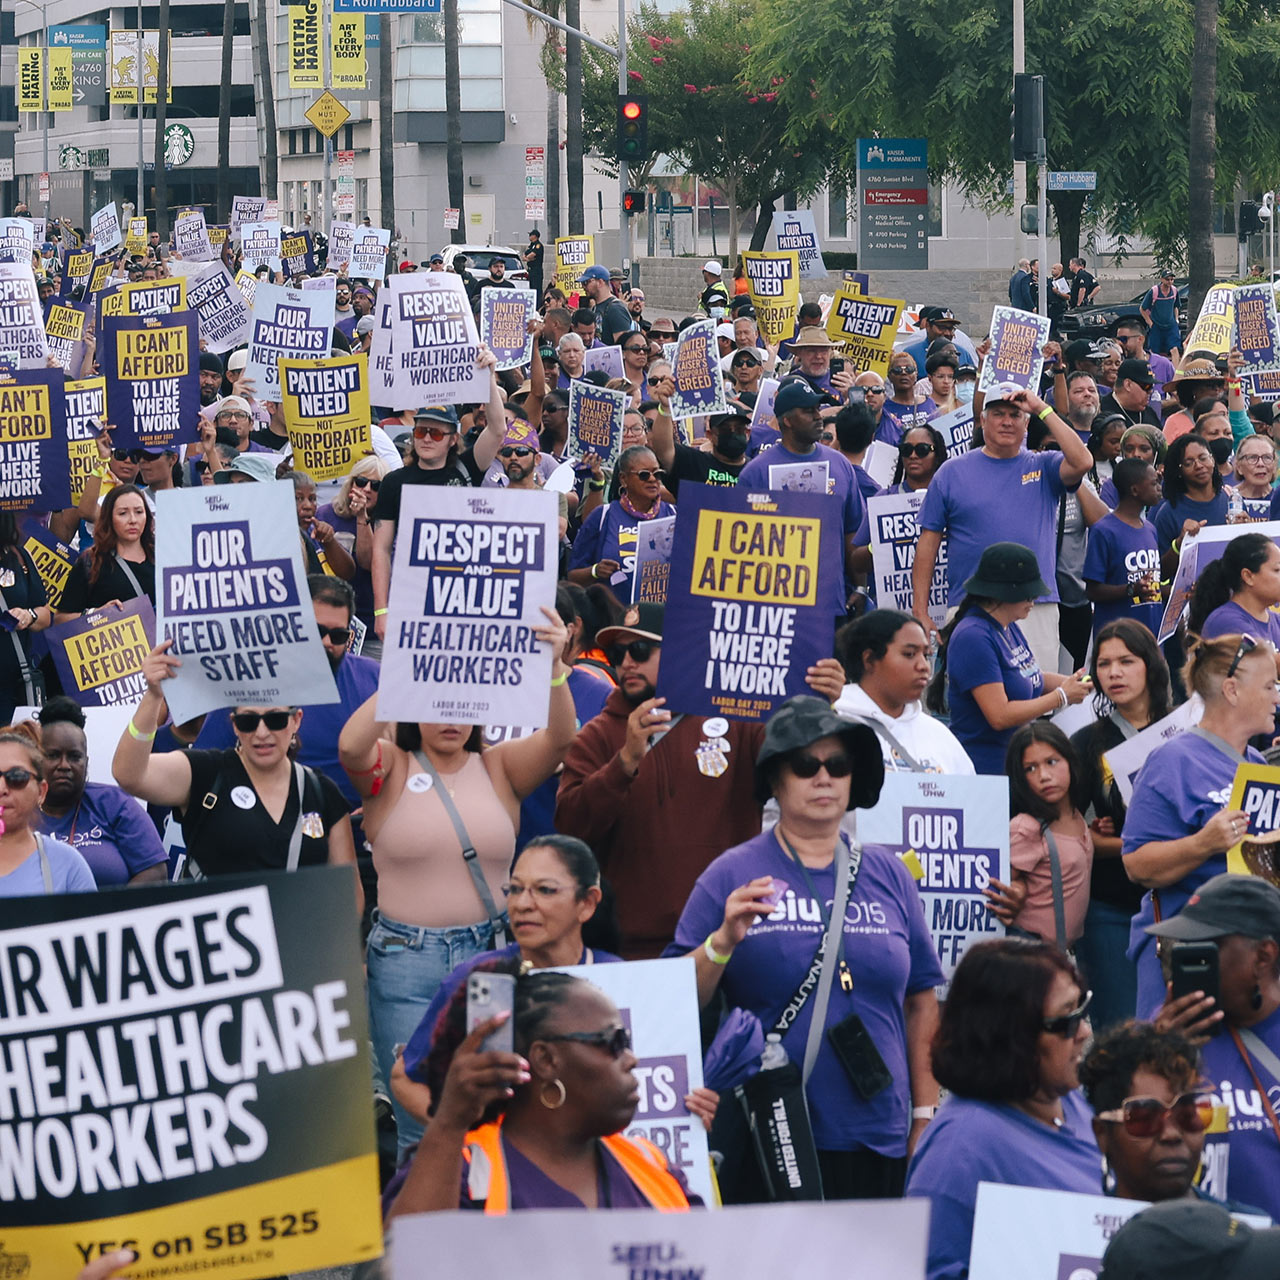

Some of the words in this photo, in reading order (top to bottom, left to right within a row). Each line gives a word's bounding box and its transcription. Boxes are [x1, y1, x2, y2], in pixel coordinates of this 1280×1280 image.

[293, 19, 305, 70] KEITH
[306, 3, 317, 70] HARING
[1057, 174, 1068, 183] Ron
[1069, 175, 1095, 183] Hubbard
[288, 367, 356, 393] PATIENT
[301, 392, 347, 416] NEED
[290, 425, 367, 450] CORPORATE
[317, 420, 333, 430] NOT
[304, 448, 351, 468] GREED
[197, 529, 246, 568] OUR
[417, 523, 540, 565] RESPECT
[713, 519, 722, 551] I
[730, 521, 812, 559] CAN'T
[464, 565, 492, 576] AND
[698, 557, 810, 599] AFFORD
[171, 567, 288, 611] PATIENTS
[433, 576, 520, 617] VALUE
[164, 620, 226, 655] NEED
[231, 612, 309, 649] MORE
[712, 601, 741, 632] TO
[745, 605, 796, 637] LIVE
[398, 621, 541, 654] HEALTHCARE
[710, 631, 792, 667] WHERE
[200, 650, 279, 682] STAFF
[413, 654, 522, 686] WORKERS
[705, 661, 714, 688] I
[720, 663, 789, 696] WORK
[51, 907, 262, 1010] WAGES
[776, 957, 824, 1030] NAUTICA
[76, 1240, 140, 1265] YES
[152, 1234, 192, 1258] on
[204, 1227, 248, 1251] SB
[260, 1210, 319, 1240] 525
